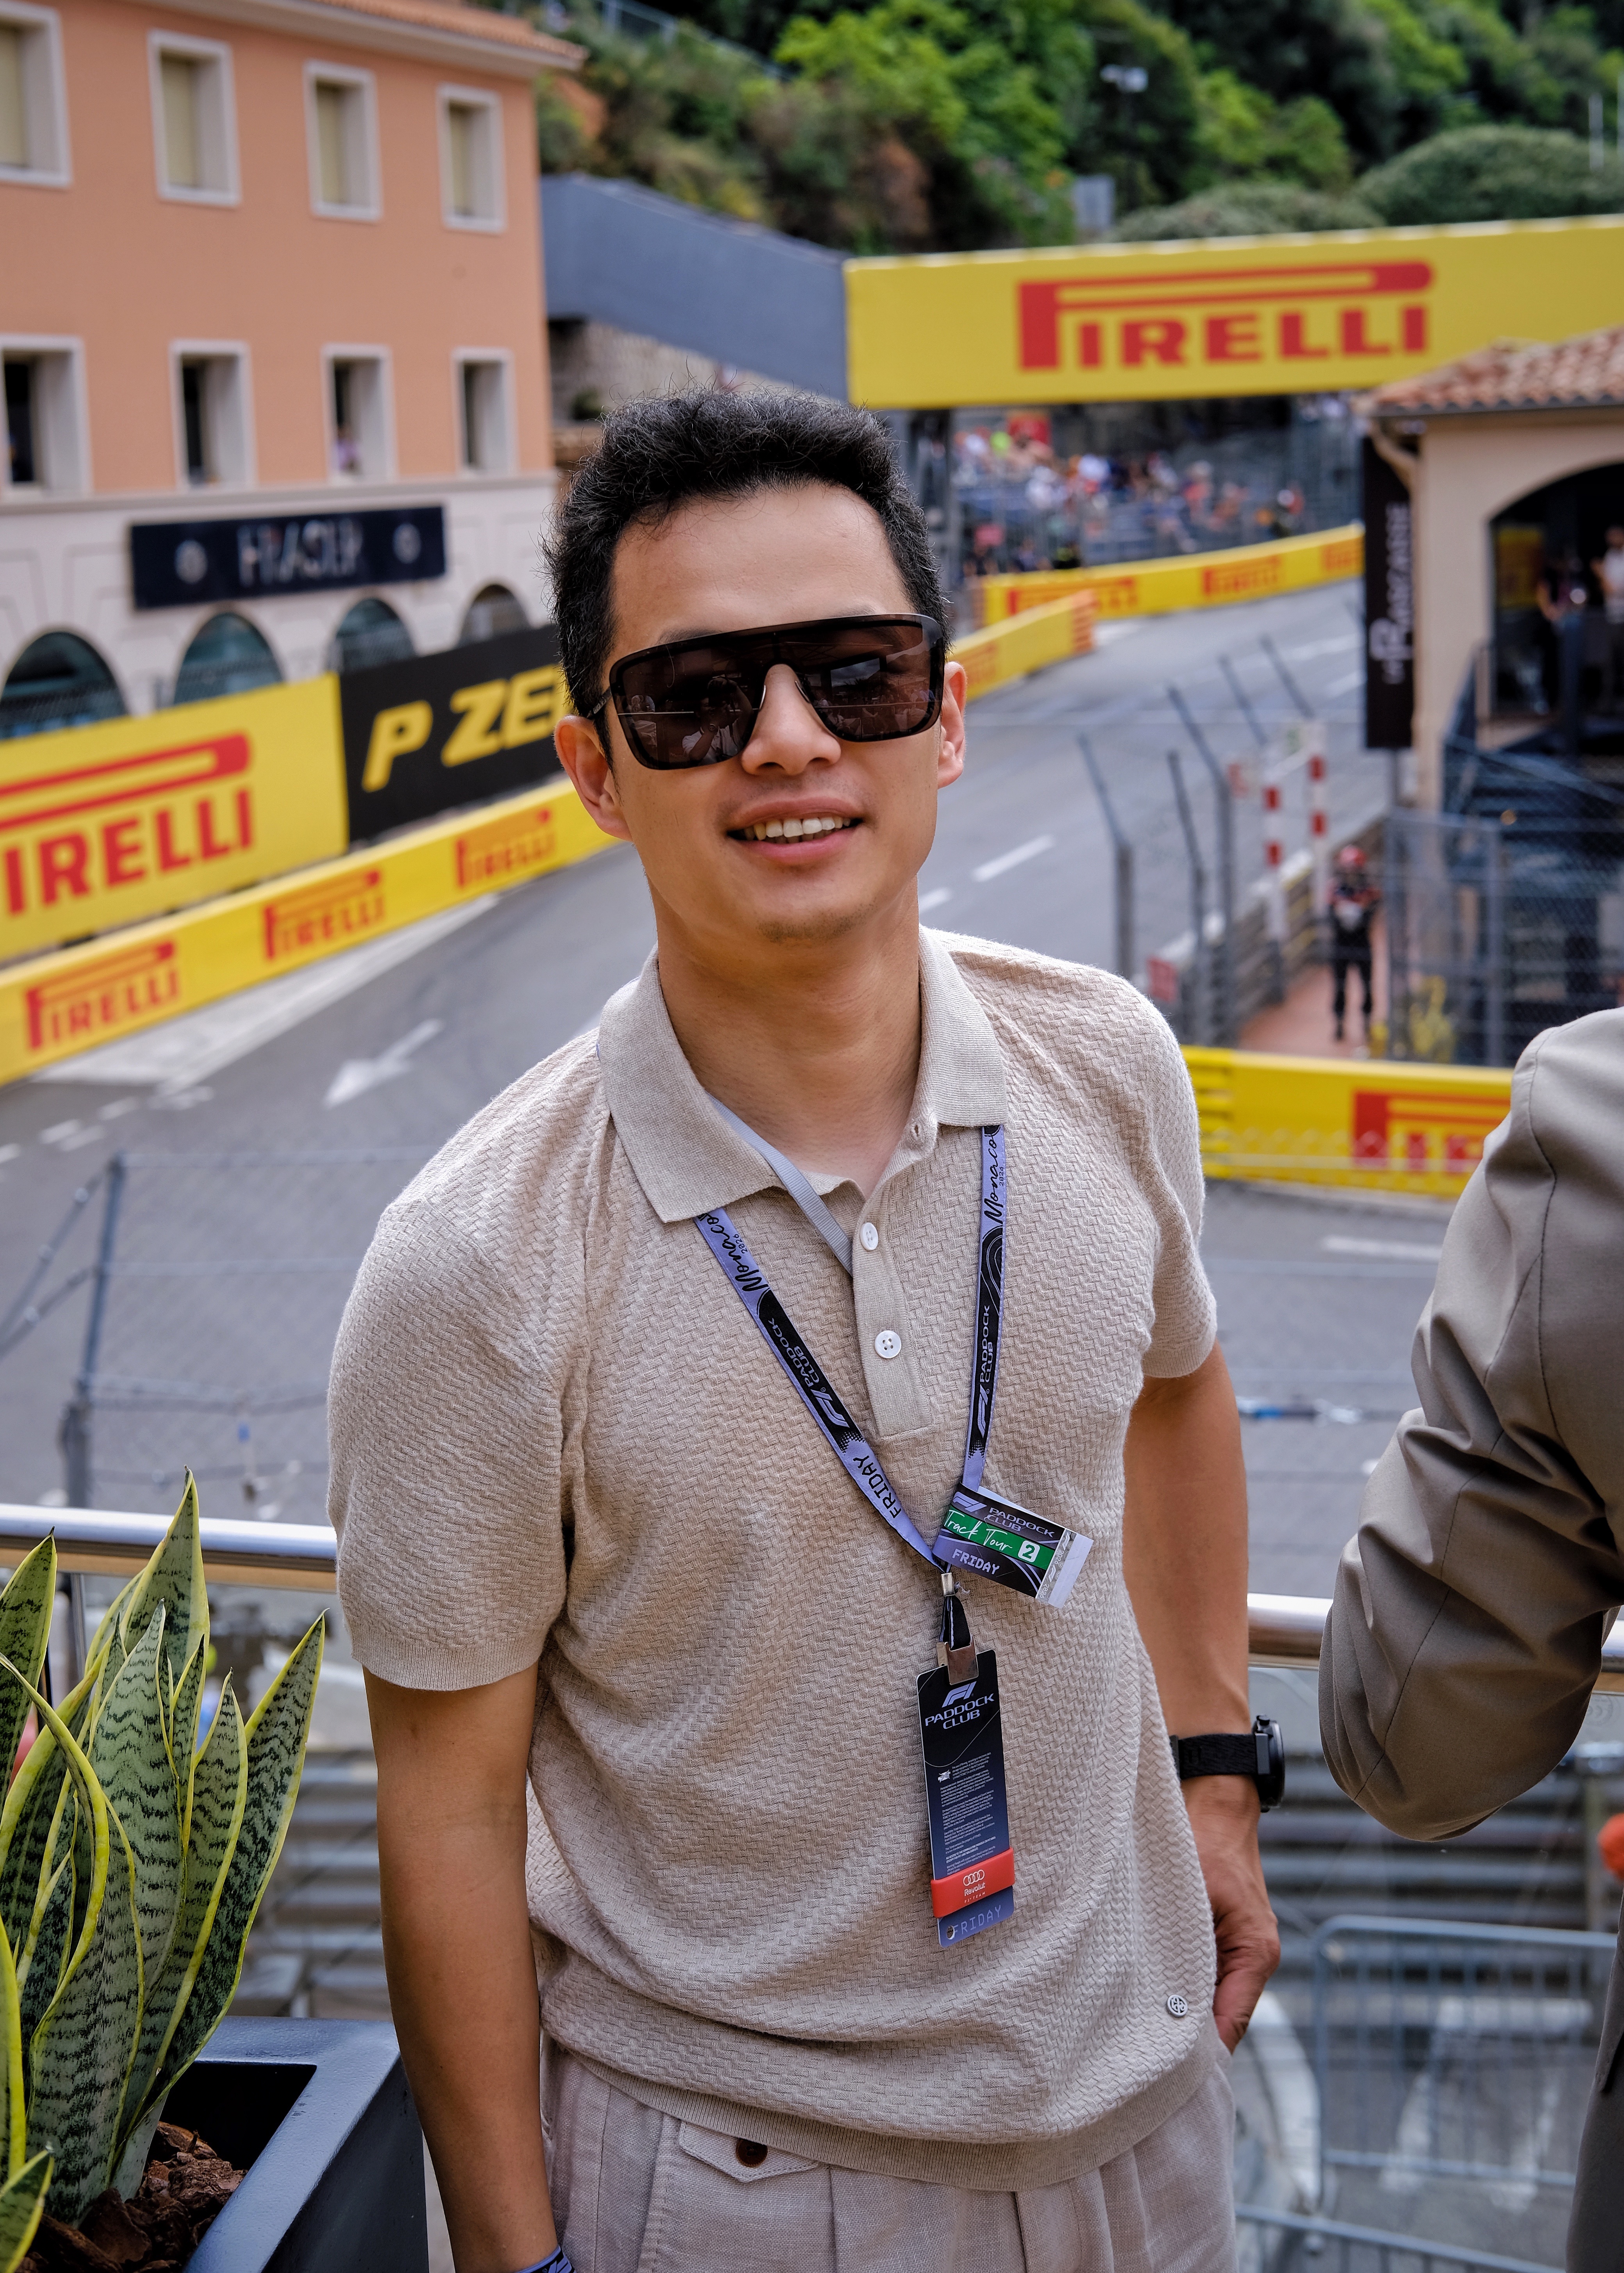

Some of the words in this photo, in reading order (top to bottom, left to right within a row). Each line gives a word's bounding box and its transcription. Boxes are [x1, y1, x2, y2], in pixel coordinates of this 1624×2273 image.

[1019, 262, 1432, 371] PIRELLI
[361, 700, 433, 793] P
[440, 664, 572, 768] ZE
[263, 870, 385, 960] PIRELLI
[26, 941, 180, 1050] PIRELLI
[984, 1134, 1004, 1225] Monaco
[706, 1213, 769, 1292] Monaco
[732, 1234, 748, 1254] 2026
[768, 1318, 814, 1387] PADDOCK
[794, 1346, 819, 1383] CLUB
[979, 1305, 990, 1382] PADDOCK
[985, 1342, 993, 1383] CLUB
[853, 1455, 902, 1518] FRIDAY
[944, 1509, 983, 1540] Track
[983, 1528, 1013, 1551] Tour
[1022, 1544, 1036, 1559] 2
[987, 1514, 1022, 1532] CLUB
[989, 1507, 1055, 1538] PADDOCK
[952, 1549, 1000, 1575] FRIDAY
[925, 1693, 995, 1727] PADDOCK
[943, 1709, 980, 1729] CLUB
[964, 1882, 986, 1897] Revolut
